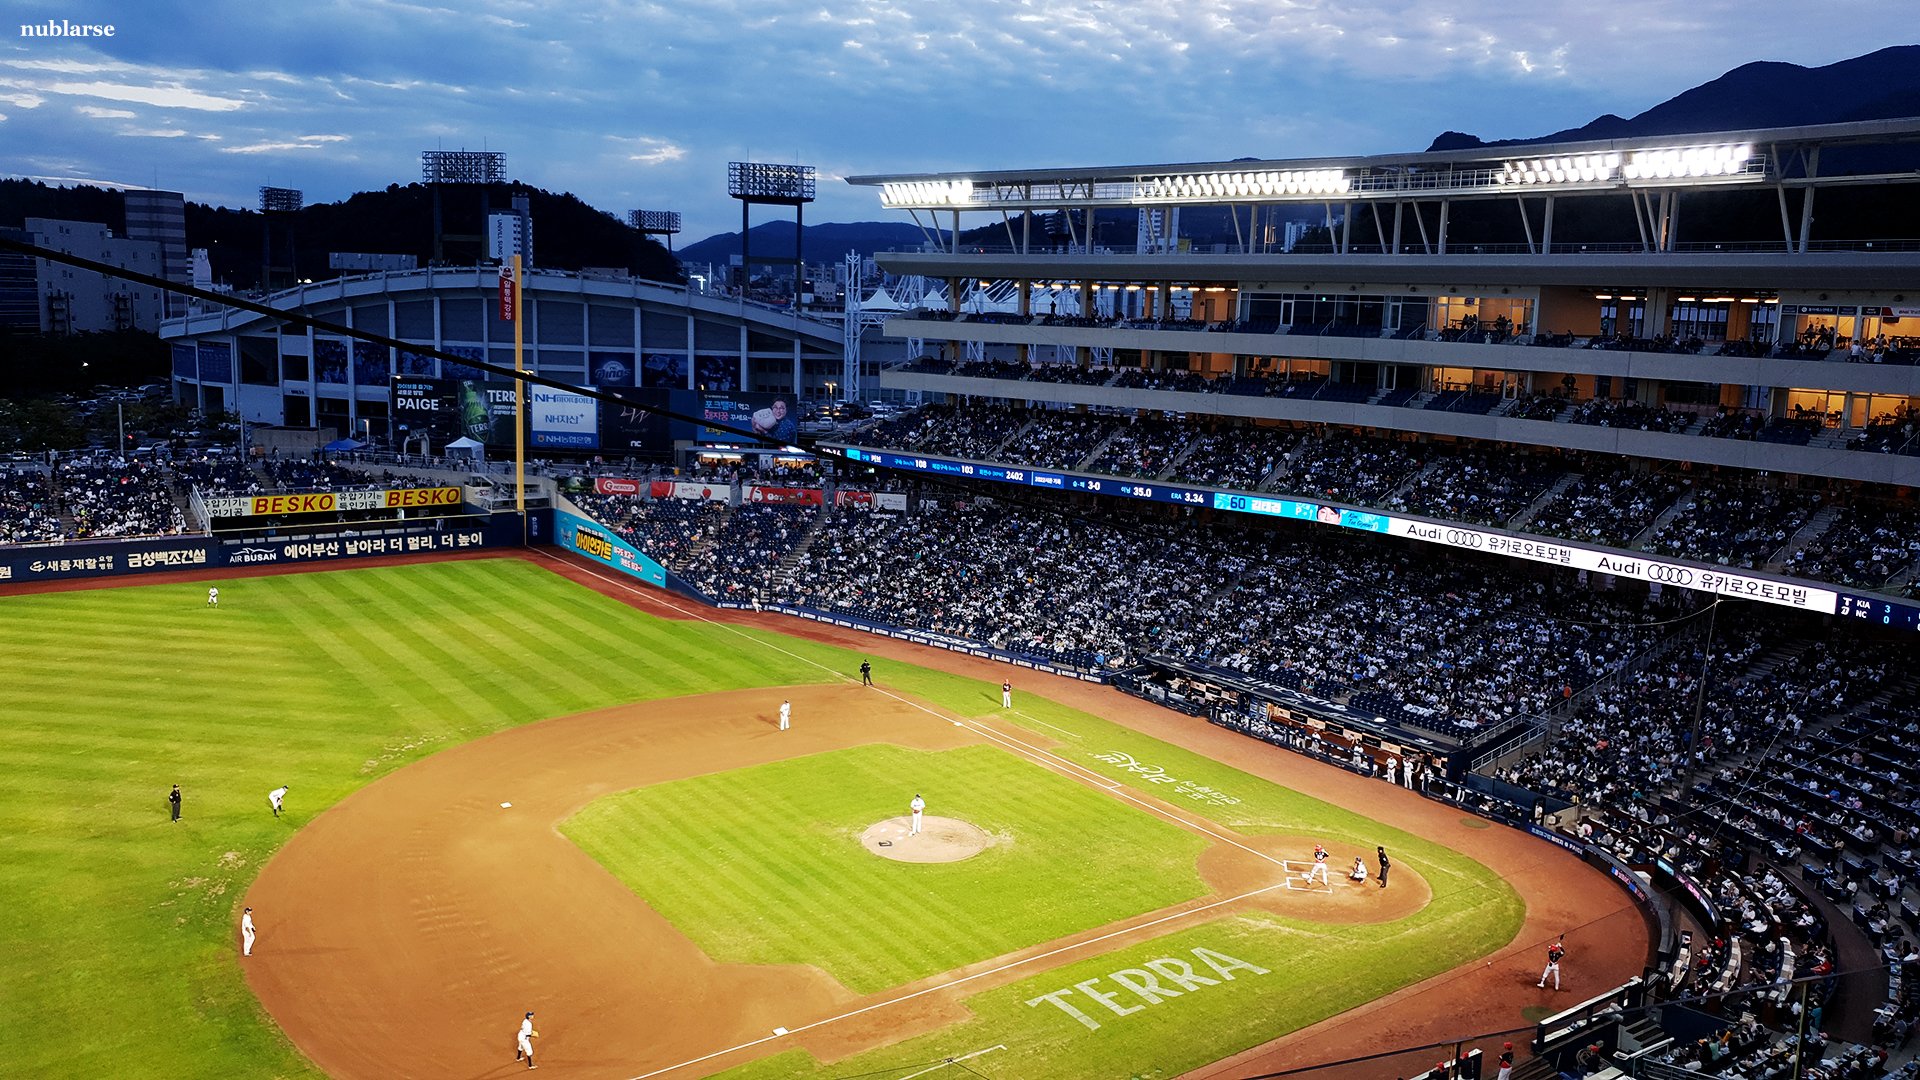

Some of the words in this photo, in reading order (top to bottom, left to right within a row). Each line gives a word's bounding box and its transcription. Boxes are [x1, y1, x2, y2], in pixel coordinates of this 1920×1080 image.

[397, 398, 439, 410] PAIGE
[546, 435, 592, 444] NH농협은행
[961, 465, 974, 474] 103
[1006, 470, 1024, 481] 2402
[339, 492, 382, 501] 유압기기는
[388, 488, 460, 506] BESKO
[1088, 480, 1100, 490] 3-0
[1133, 486, 1152, 498] 35.0
[1170, 492, 1182, 500] ERA
[1184, 492, 1204, 504] 3.34
[254, 494, 335, 514] BESKO
[1230, 496, 1246, 510] 60
[284, 542, 339, 558] 에어부산
[346, 539, 386, 554] 날아라
[390, 538, 403, 552] 더
[407, 535, 437, 550] 멀리,
[442, 533, 454, 547] 더
[458, 532, 483, 546] 높이
[576, 532, 613, 561] 아이언카트
[1407, 524, 1442, 543] Audi
[1488, 537, 1572, 564] 유카로오토모빌
[128, 548, 206, 568] 금성백조건설
[230, 553, 243, 564] AIR
[244, 552, 276, 562] BUSAN
[1598, 557, 1642, 578] Audi
[1700, 573, 1806, 606] 유카로오토모빌
[1856, 600, 1871, 610] KIA
[1884, 604, 1891, 614] 3
[1856, 610, 1868, 618] NC
[1883, 615, 1890, 624] 0
[1024, 947, 1272, 1031] TERRA
